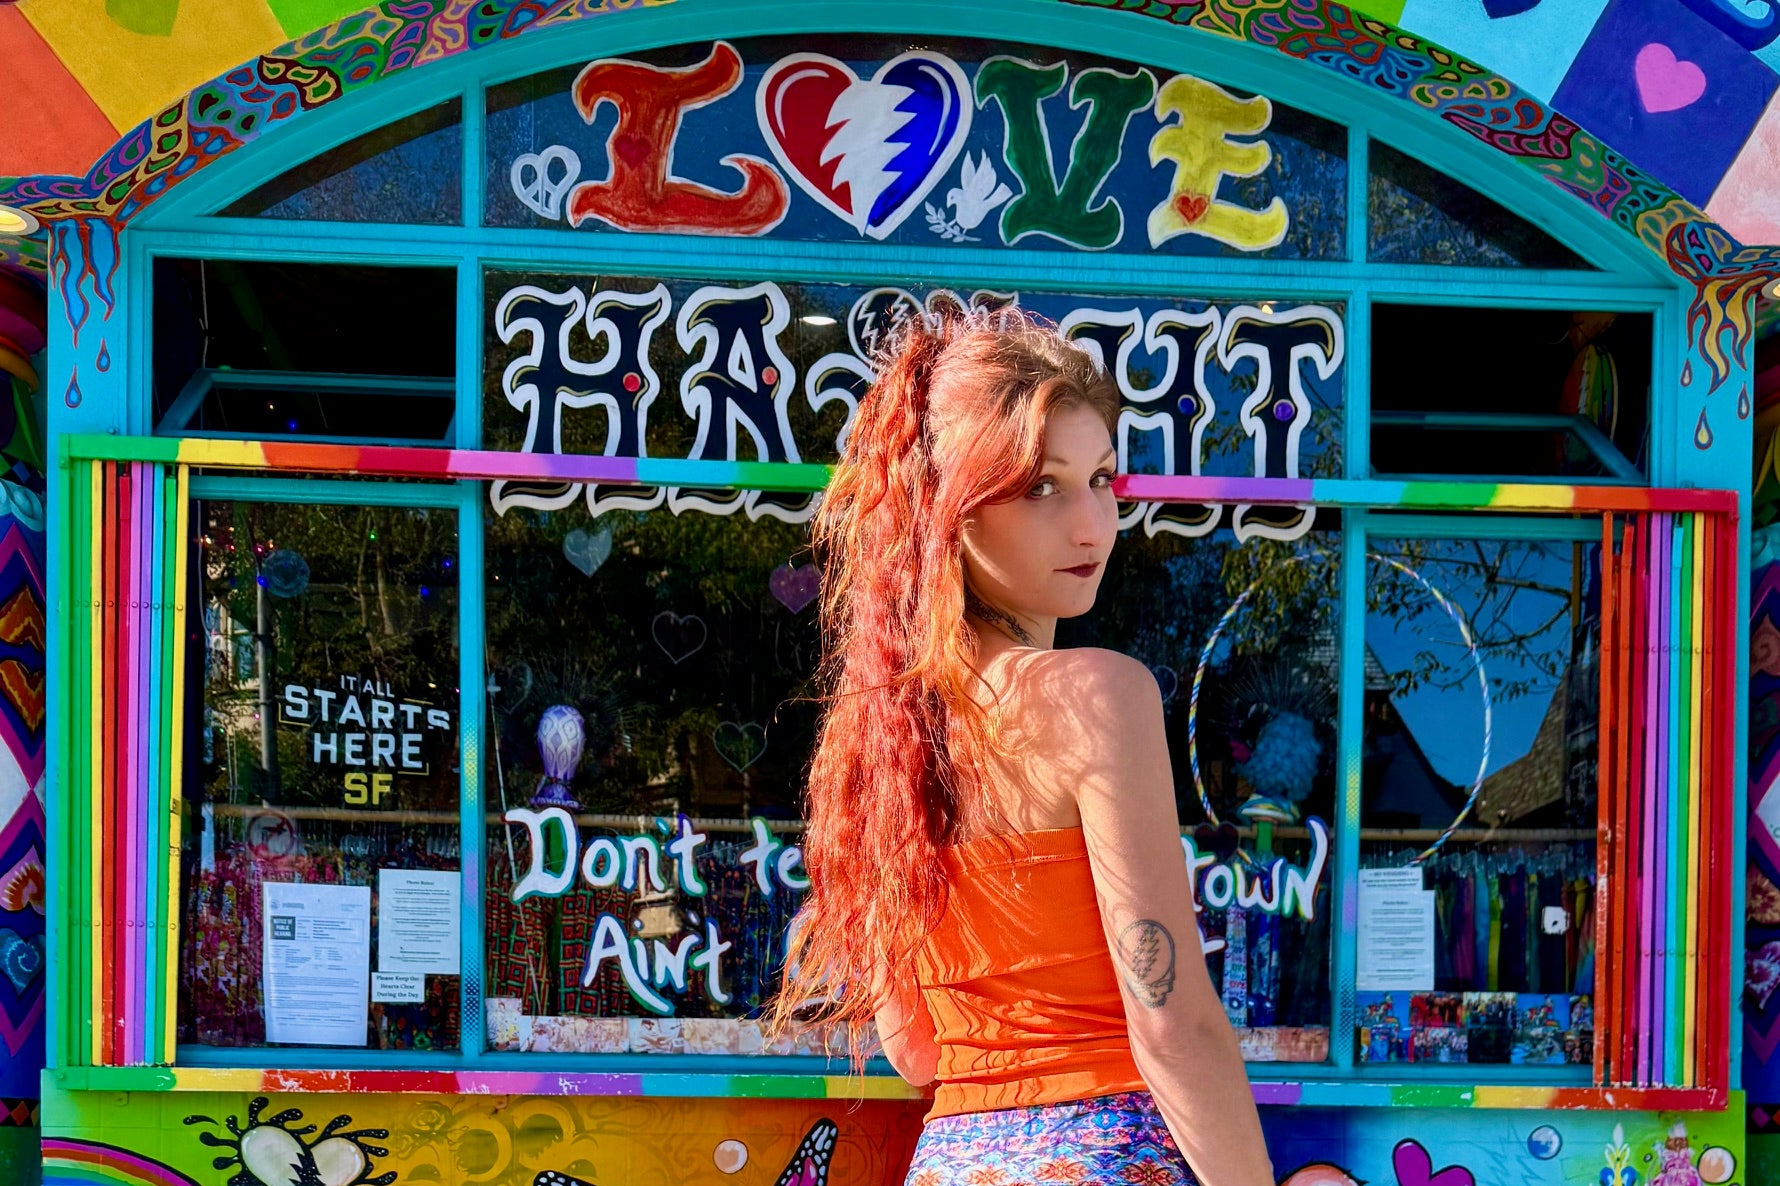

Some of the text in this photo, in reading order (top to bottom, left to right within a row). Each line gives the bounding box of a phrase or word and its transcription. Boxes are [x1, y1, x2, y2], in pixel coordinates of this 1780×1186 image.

[490, 281, 1345, 542] HAHT
[340, 674, 396, 699] IT ALL
[284, 683, 451, 731] STARTS
[313, 732, 424, 769] HERE
[343, 772, 394, 806] SF
